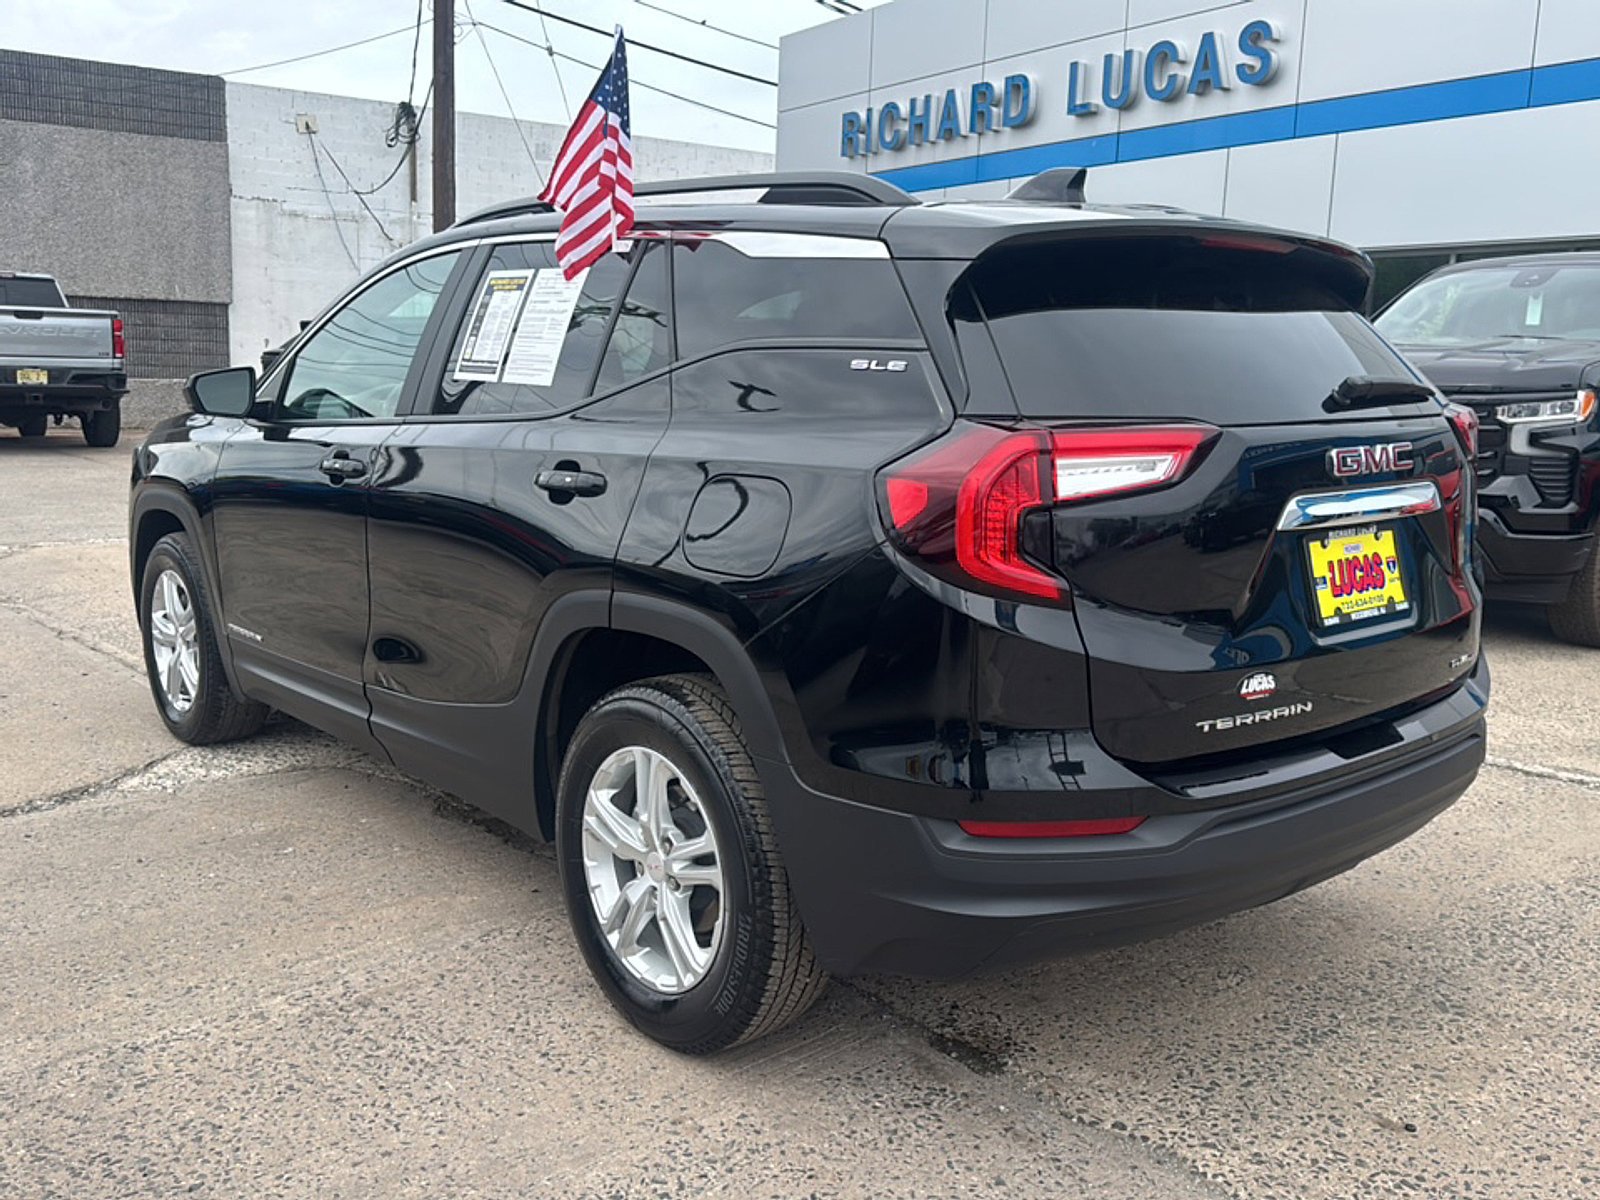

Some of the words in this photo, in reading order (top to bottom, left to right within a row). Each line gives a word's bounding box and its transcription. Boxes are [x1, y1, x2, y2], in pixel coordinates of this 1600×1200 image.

[840, 73, 1037, 158] RICHARD
[1066, 20, 1280, 117] LUCAS
[850, 359, 908, 371] SLE
[1331, 441, 1413, 476] GMC
[1328, 553, 1385, 597] LUCAS
[1240, 675, 1276, 694] LUCAS
[1195, 701, 1314, 733] TERRAIN
